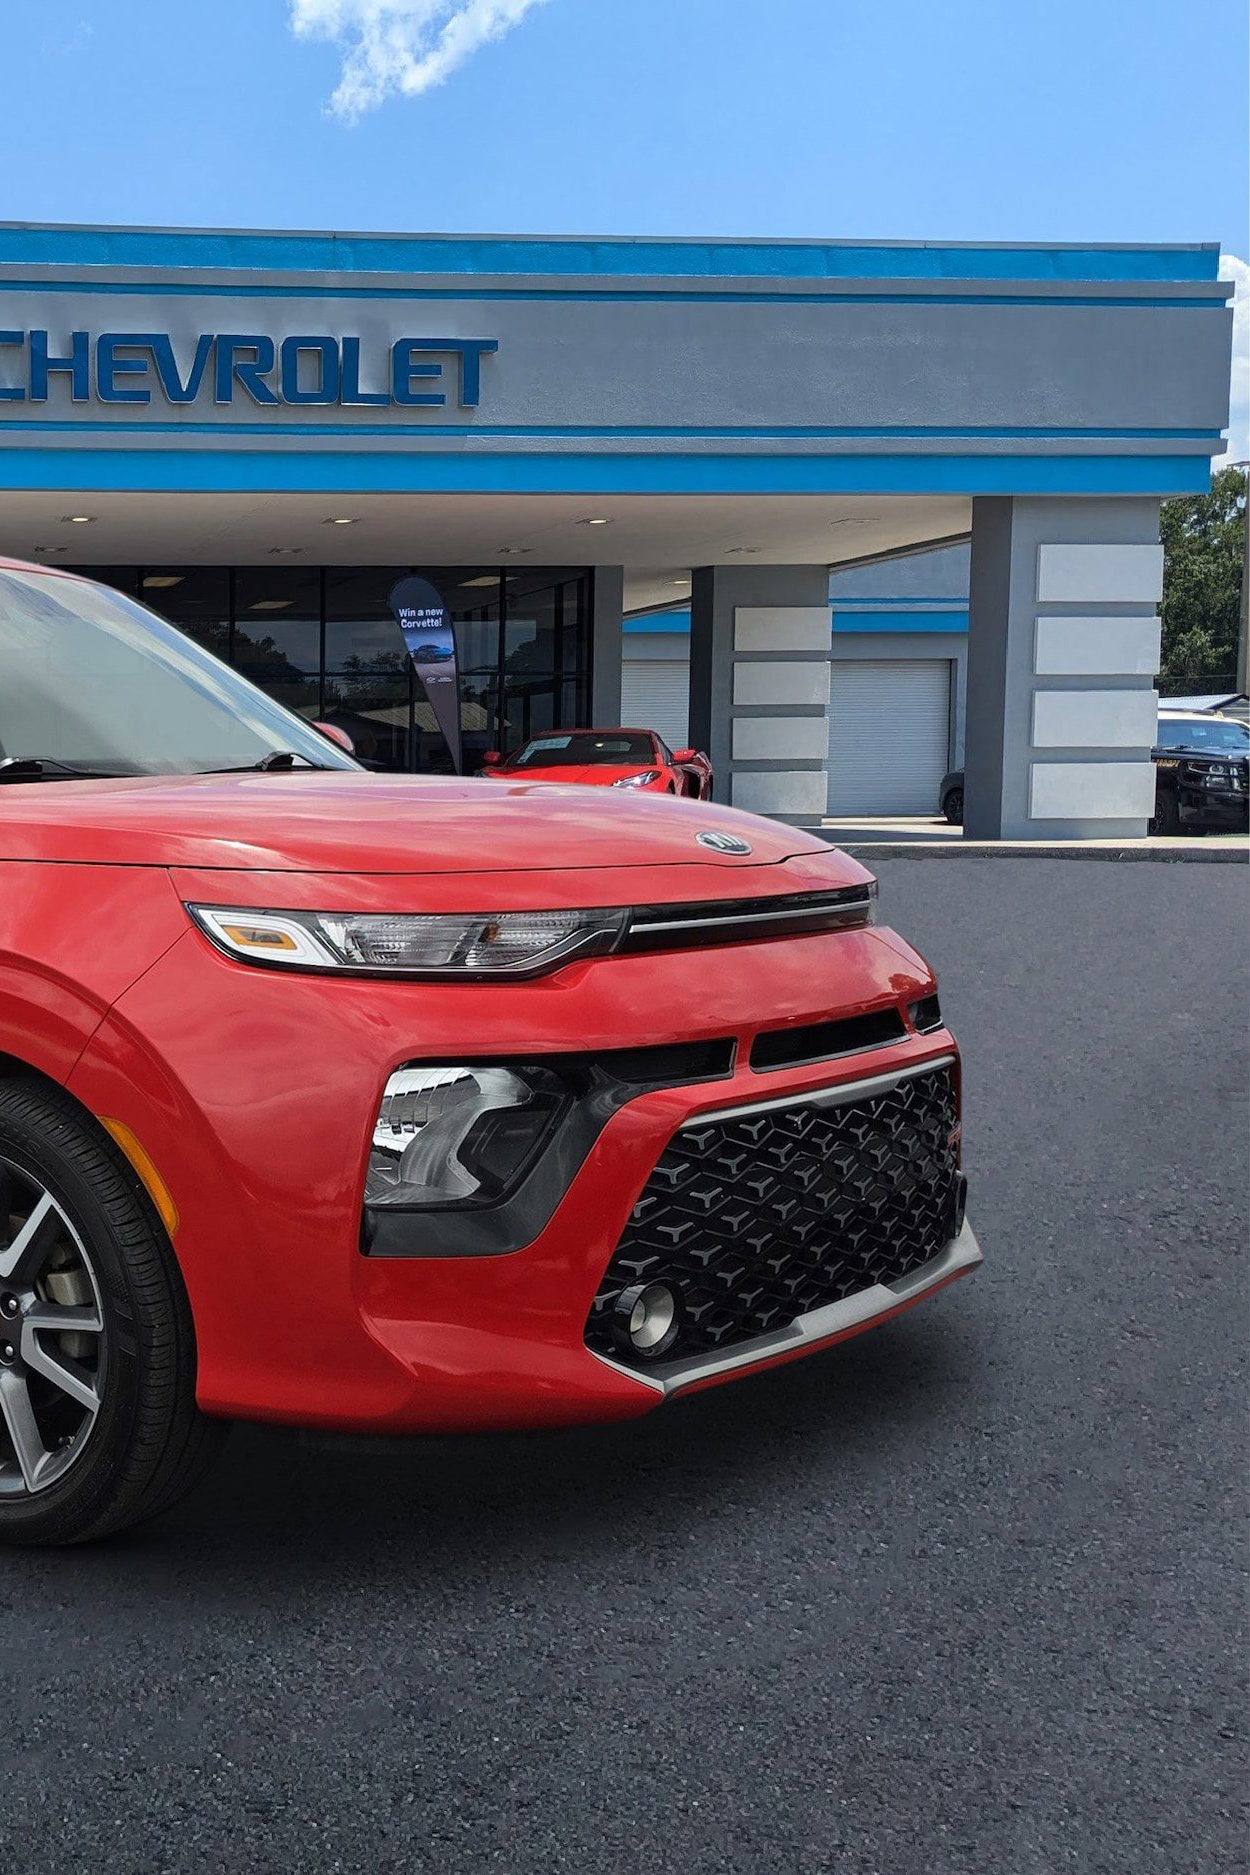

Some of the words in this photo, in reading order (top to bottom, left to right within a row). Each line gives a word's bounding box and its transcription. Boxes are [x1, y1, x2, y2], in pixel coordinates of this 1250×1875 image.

[398, 608, 416, 617] Win
[425, 608, 444, 616] new
[401, 617, 442, 629] Corvette!
